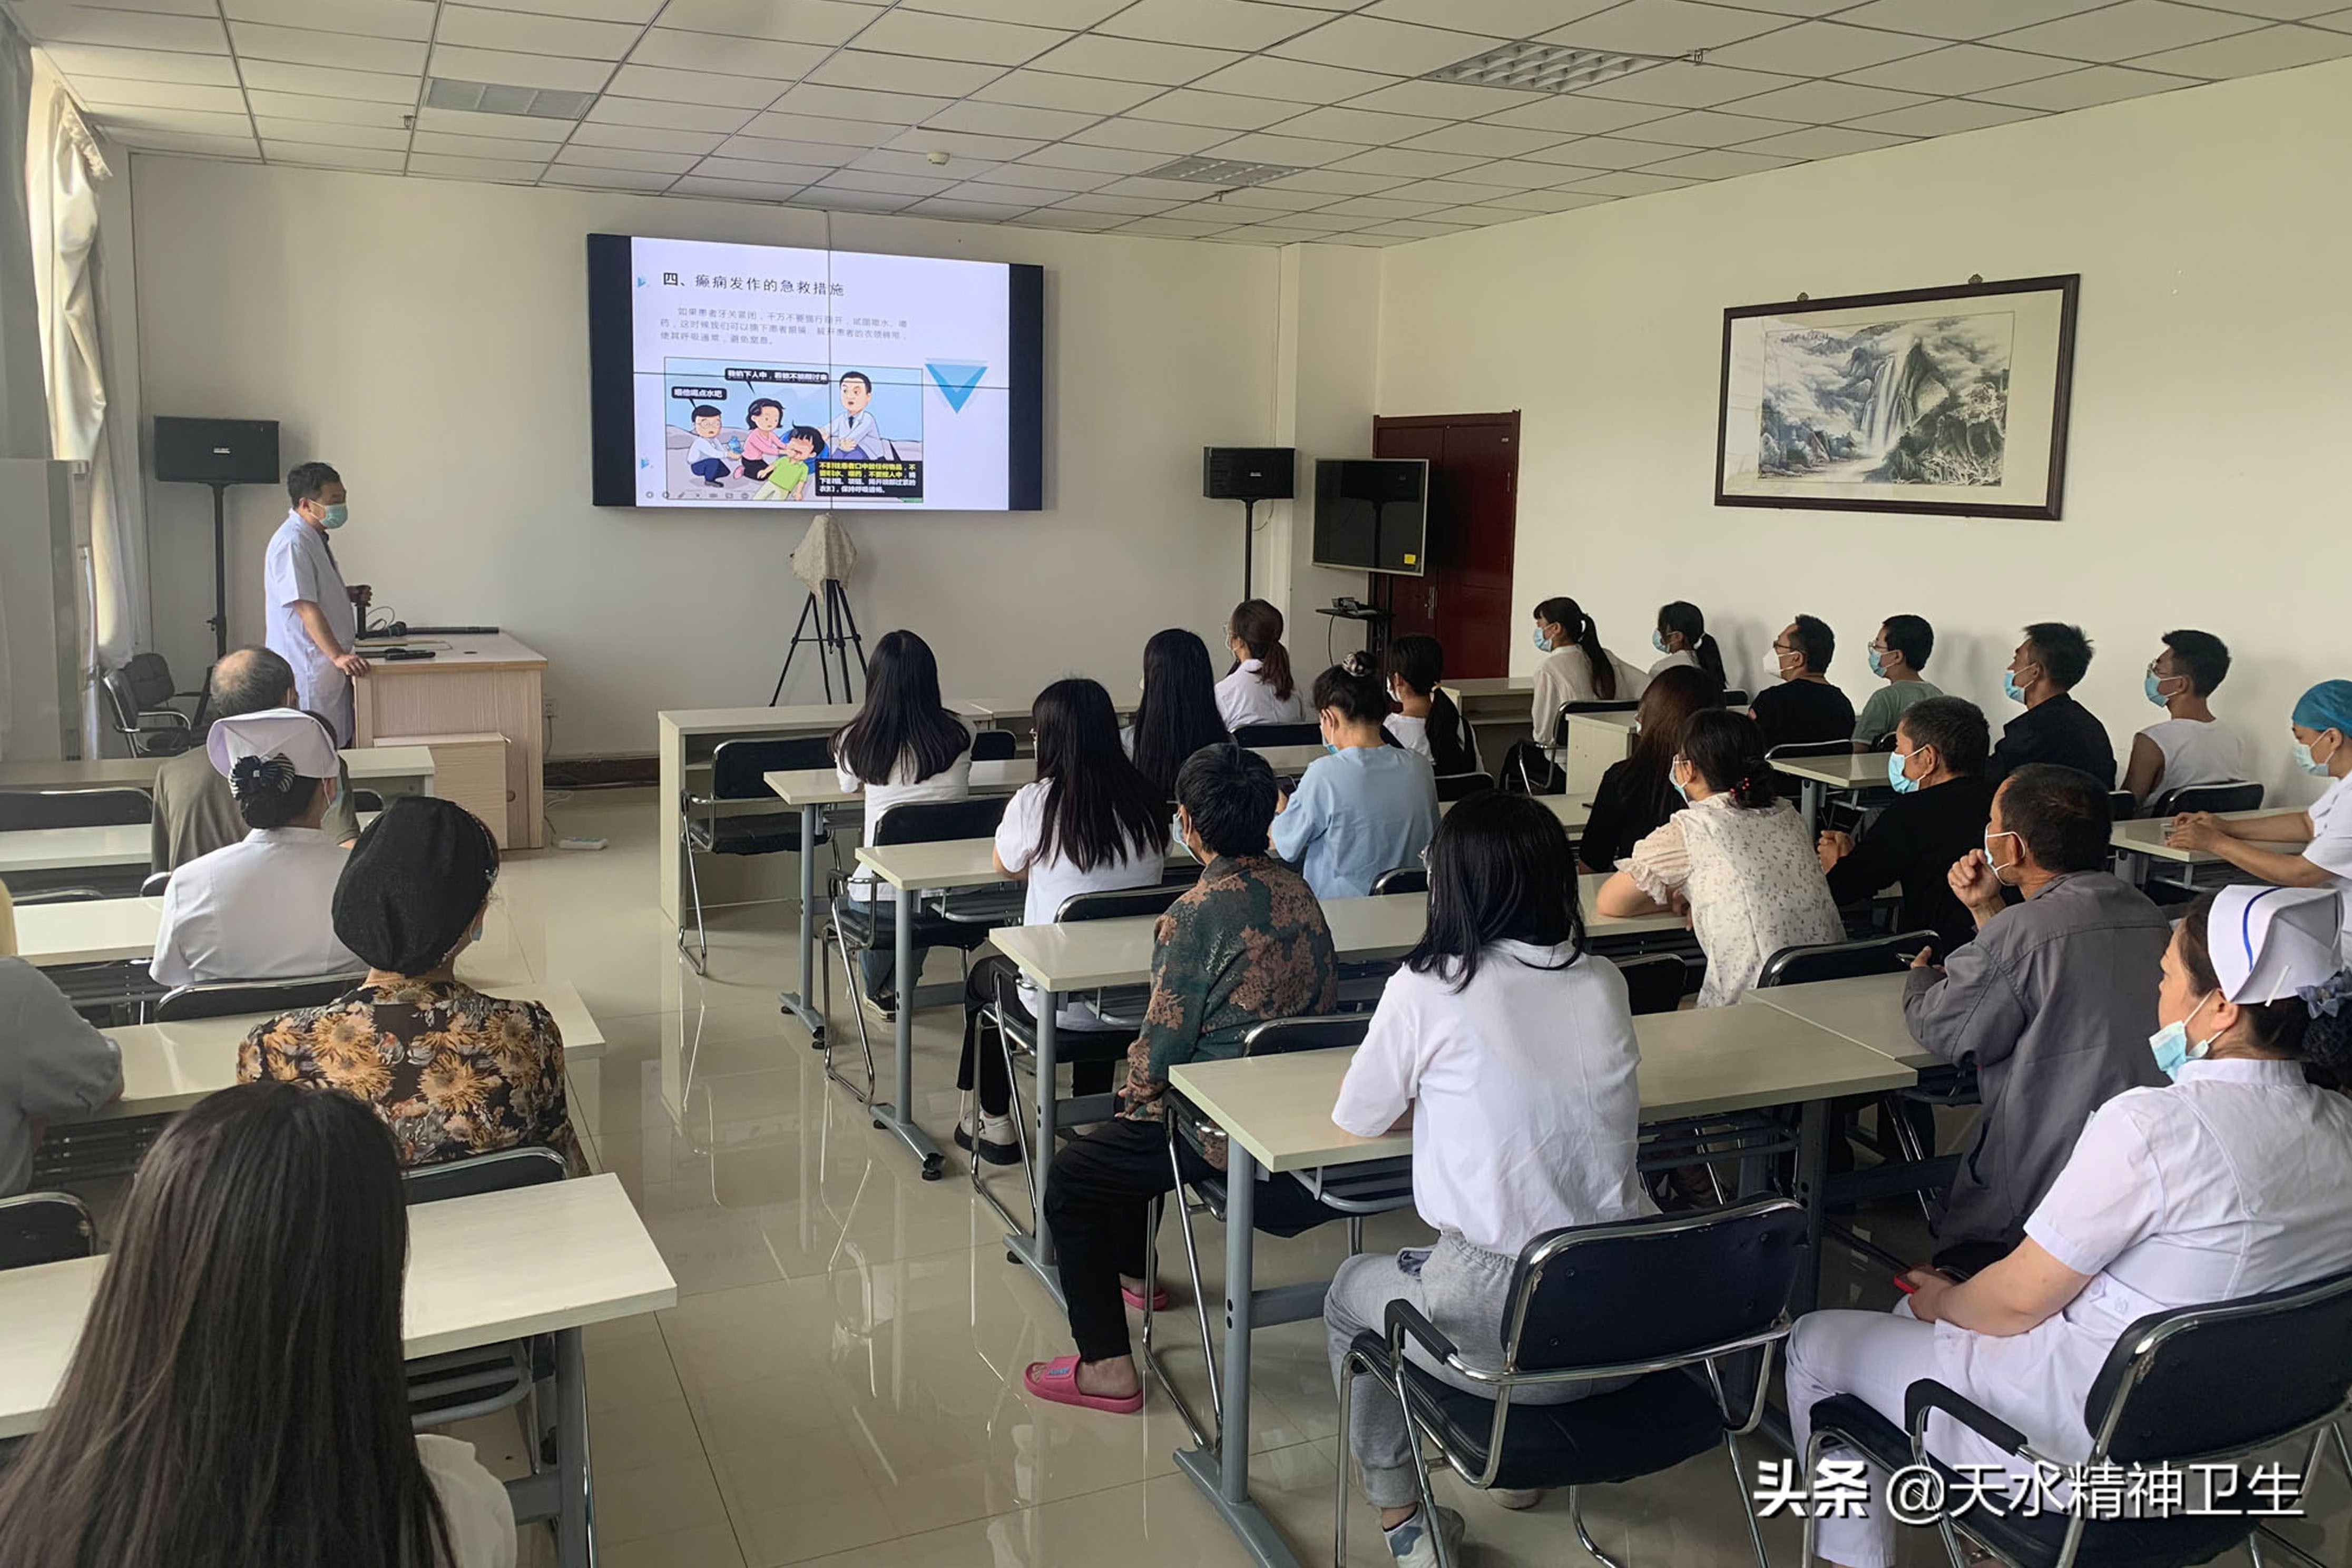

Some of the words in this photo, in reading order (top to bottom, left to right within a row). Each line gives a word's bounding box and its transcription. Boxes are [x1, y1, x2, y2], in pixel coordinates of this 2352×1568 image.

[663, 272, 845, 296] 四、癫痫发作的急救措施
